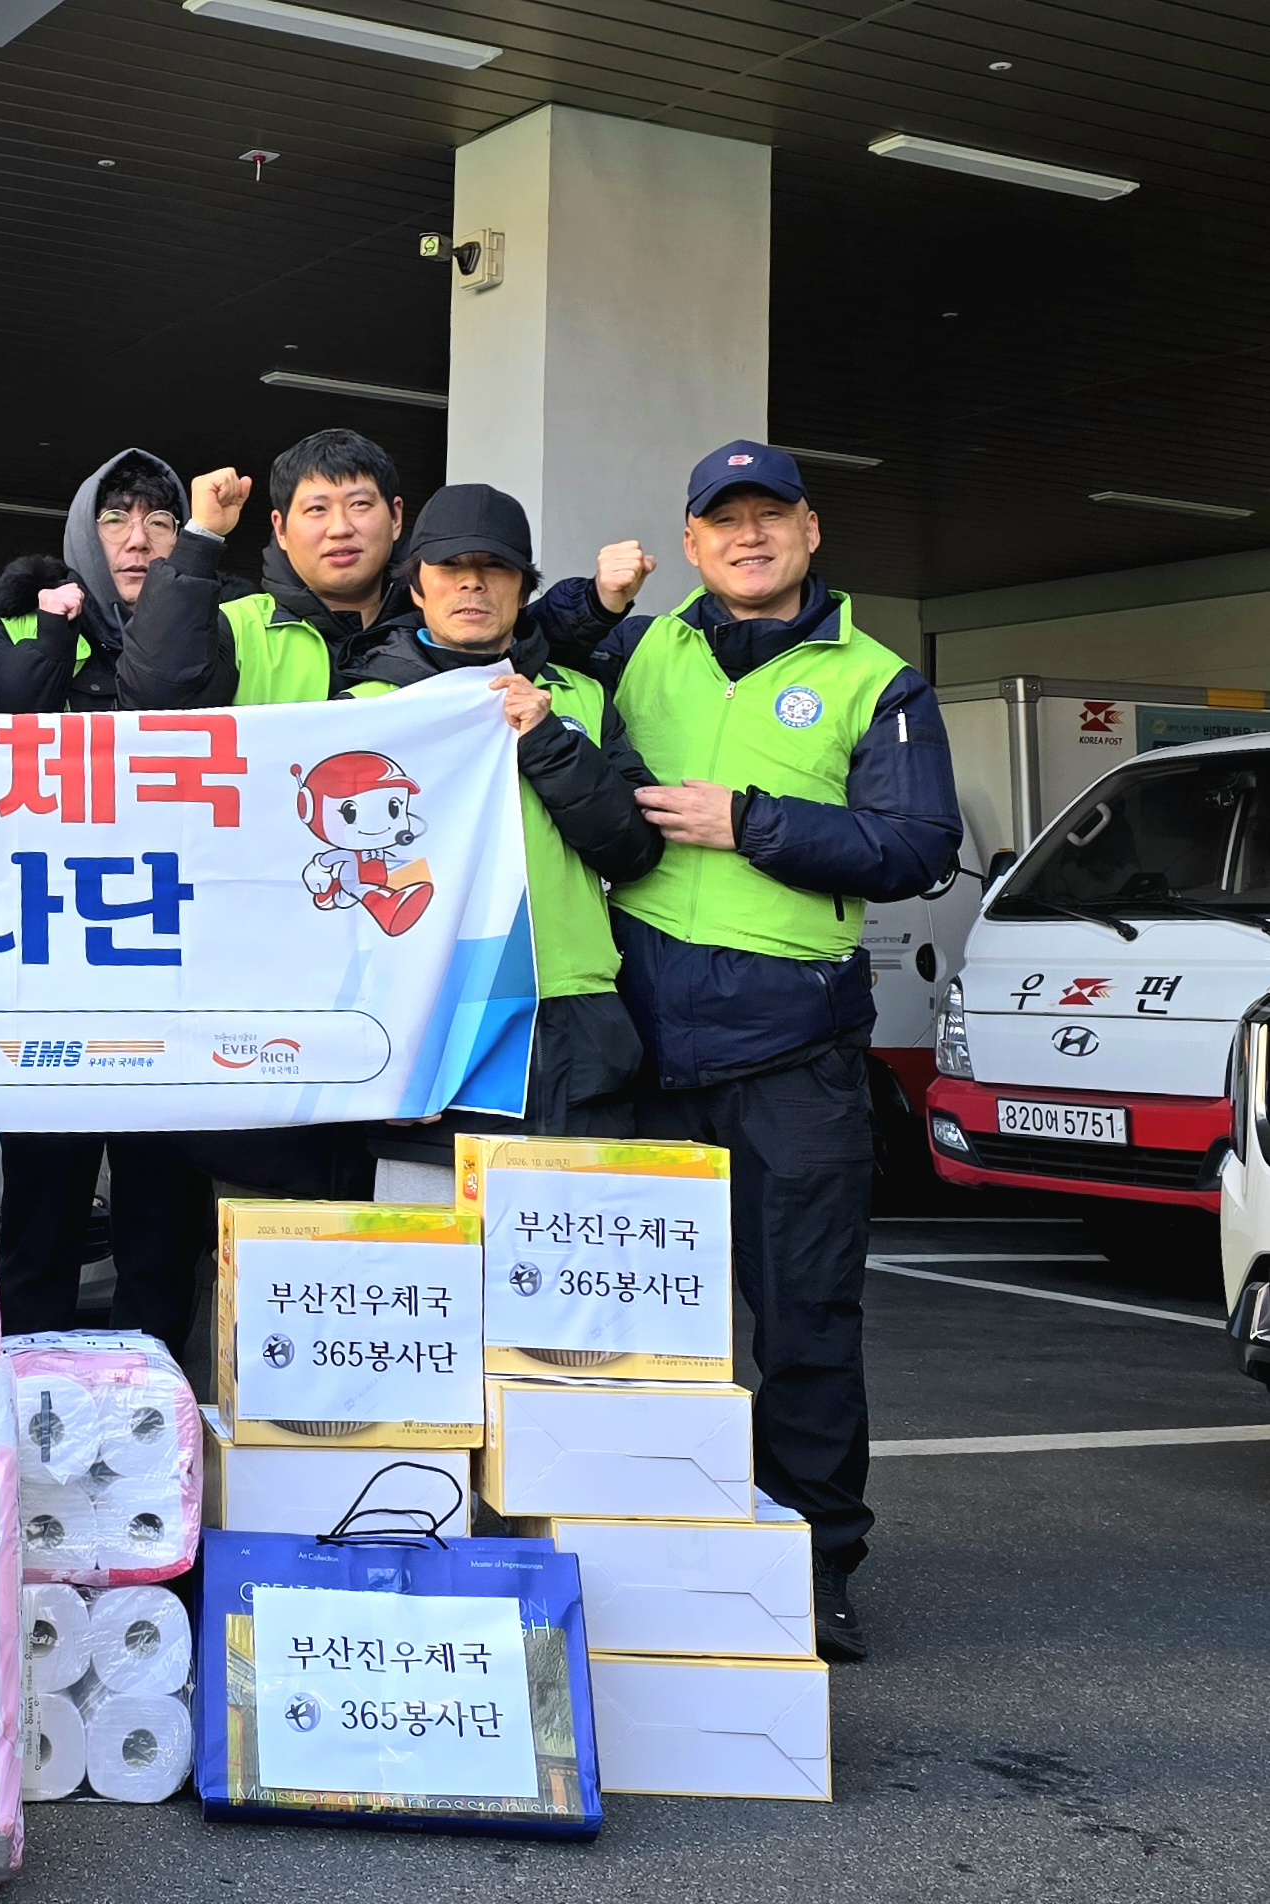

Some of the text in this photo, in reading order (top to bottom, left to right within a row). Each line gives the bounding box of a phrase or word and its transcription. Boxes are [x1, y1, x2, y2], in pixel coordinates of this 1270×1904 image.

[1079, 736, 1123, 746] KOREA POST
[1010, 973, 1183, 1015] 우 편
[20, 1040, 83, 1067] EMS
[222, 1043, 258, 1055] EVER
[260, 1052, 294, 1063] RICH
[507, 1157, 529, 1166] 2026.
[532, 1158, 543, 1167] 10.
[257, 1226, 279, 1235] 2026.
[282, 1227, 293, 1235] 10.
[514, 1211, 699, 1251] 부산진우체국
[267, 1282, 452, 1318] 부산진우체국
[559, 1269, 705, 1307] 365봉사단
[312, 1340, 458, 1374] 365봉사단
[308, 1553, 339, 1562] Collection
[471, 1560, 493, 1569] Master
[502, 1561, 543, 1570] Impressionism
[287, 1636, 492, 1675] 부산진우체국
[340, 1700, 503, 1738] 365봉사단
